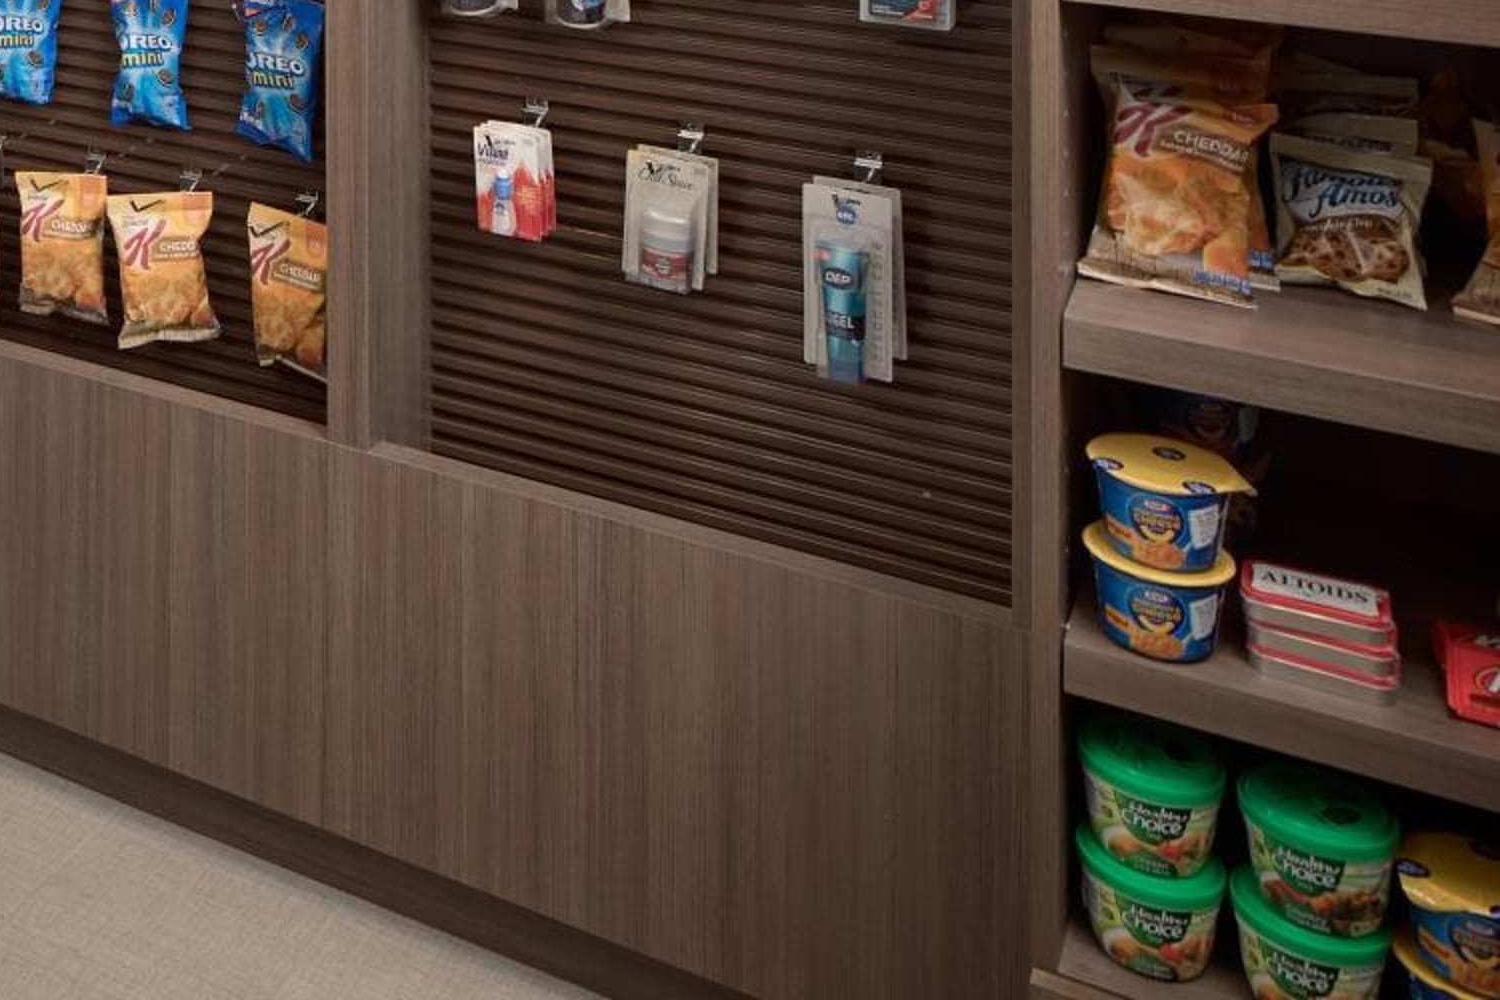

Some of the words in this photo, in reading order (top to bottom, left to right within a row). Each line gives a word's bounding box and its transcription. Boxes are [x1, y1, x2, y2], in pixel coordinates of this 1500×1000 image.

[122, 50, 164, 68] mini
[1172, 128, 1248, 163] CHEDDAR
[1308, 181, 1399, 219] Amos
[1260, 568, 1371, 605] ALTOIDS
